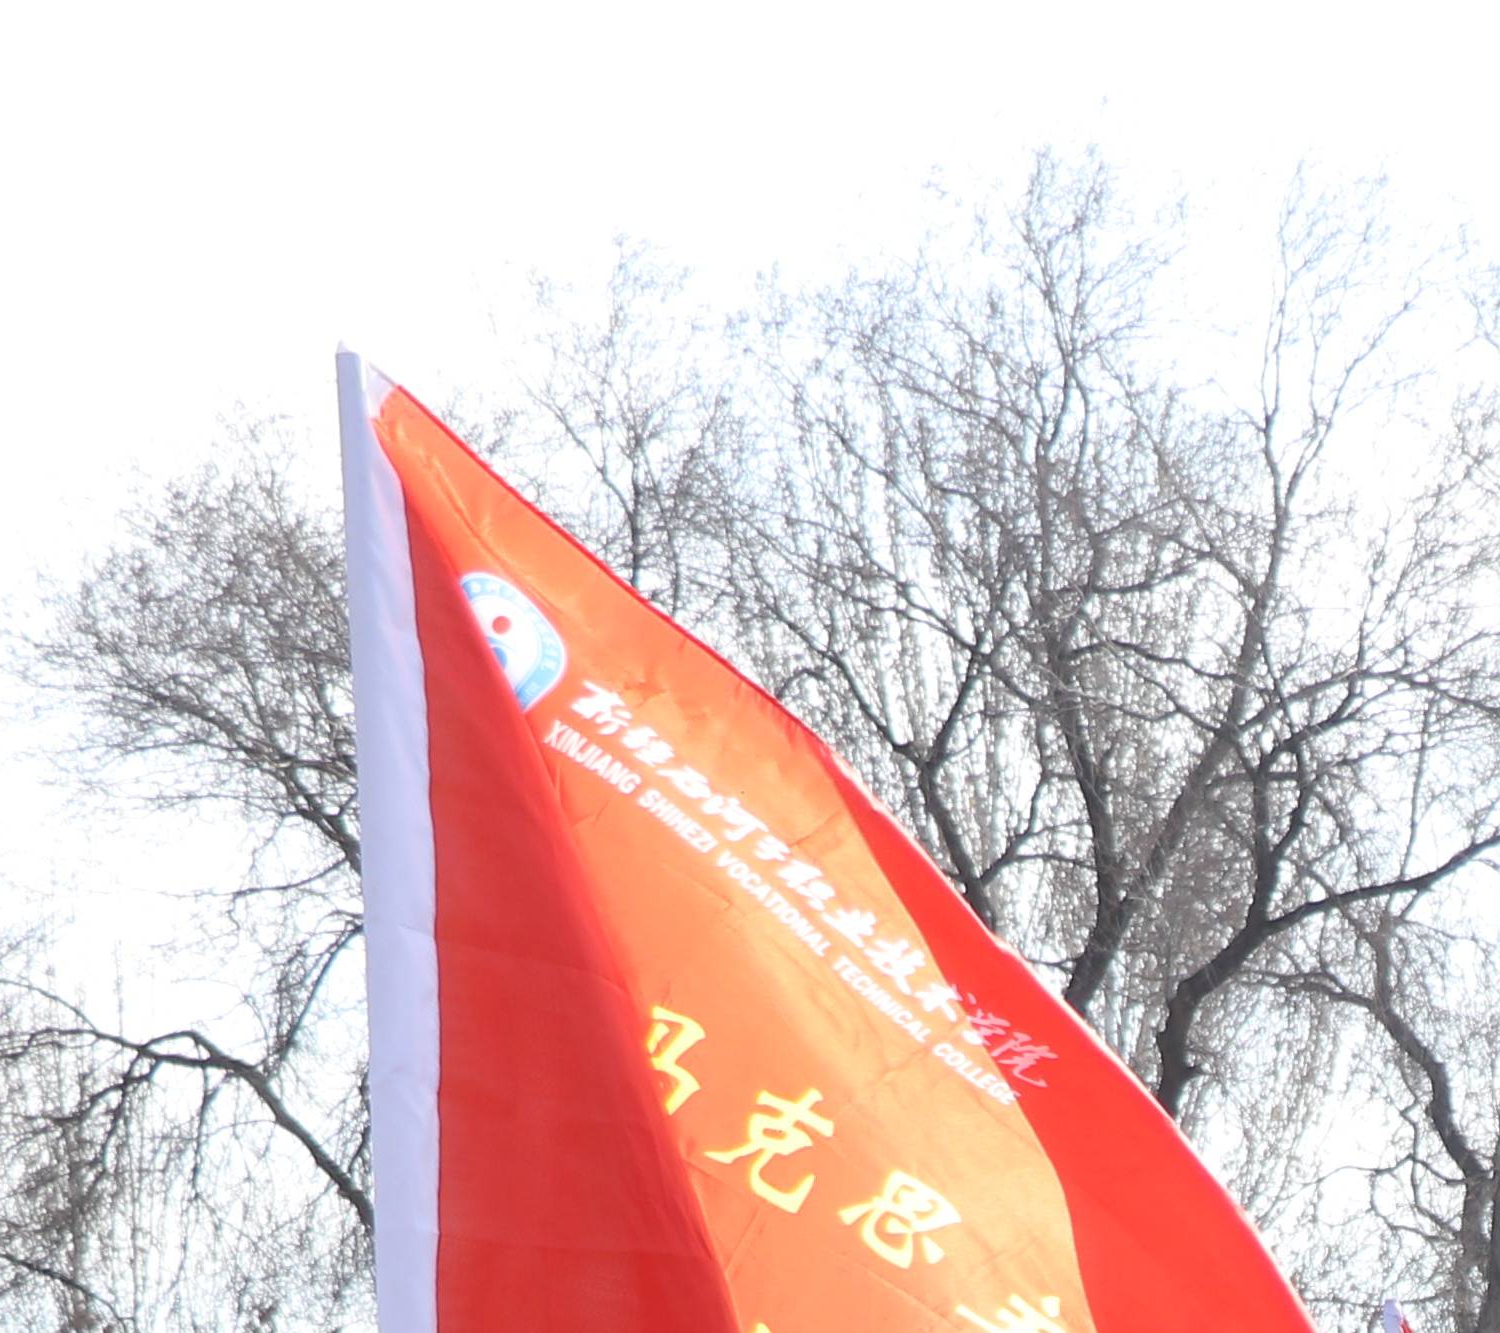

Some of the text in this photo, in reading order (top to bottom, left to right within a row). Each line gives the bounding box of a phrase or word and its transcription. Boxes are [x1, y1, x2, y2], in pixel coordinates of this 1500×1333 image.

[544, 719, 1022, 1106] XINJIANG SHIHEZI VOCATIONAL TECHNICAL COLLEGE
